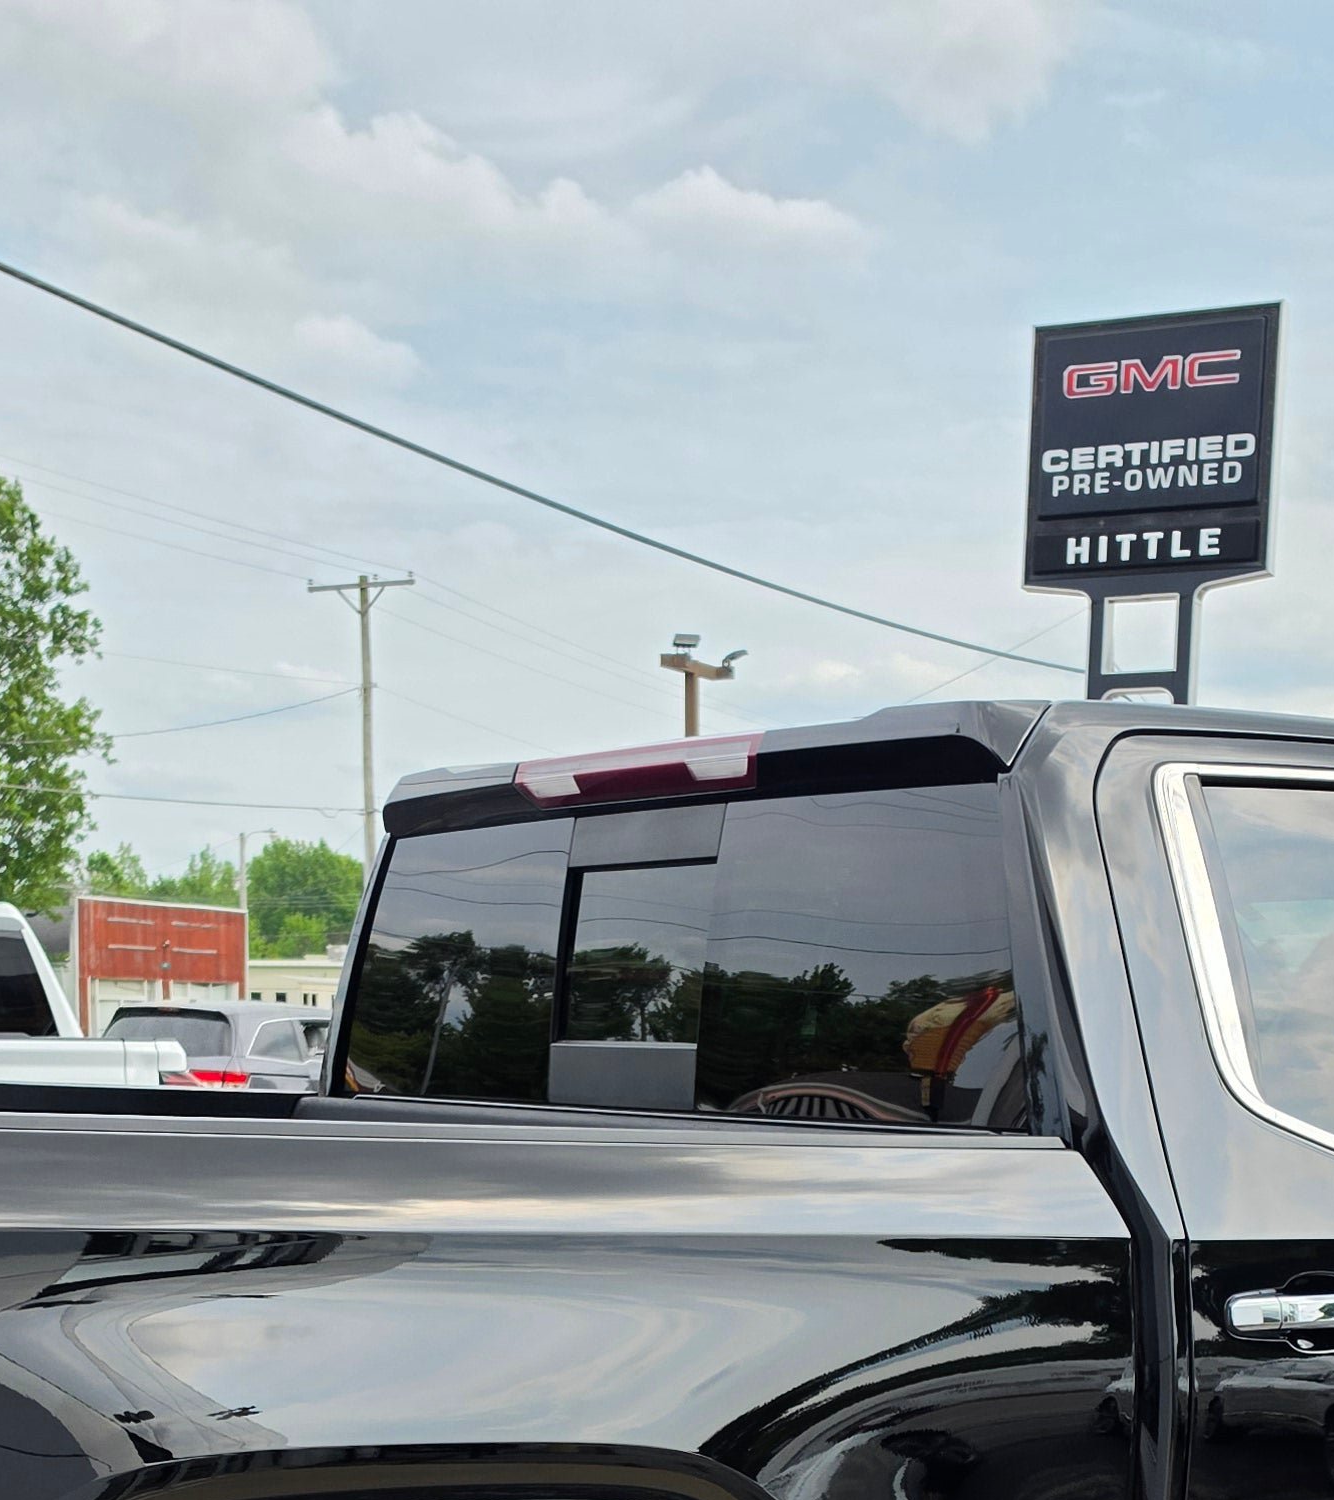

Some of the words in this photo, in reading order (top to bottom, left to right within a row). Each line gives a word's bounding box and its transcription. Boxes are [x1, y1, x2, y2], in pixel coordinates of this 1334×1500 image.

[1062, 349, 1242, 399] GMC
[1041, 433, 1256, 473] CERTIFIED
[1052, 461, 1243, 497] PRE-OWNED
[1066, 528, 1222, 565] HITTLE
